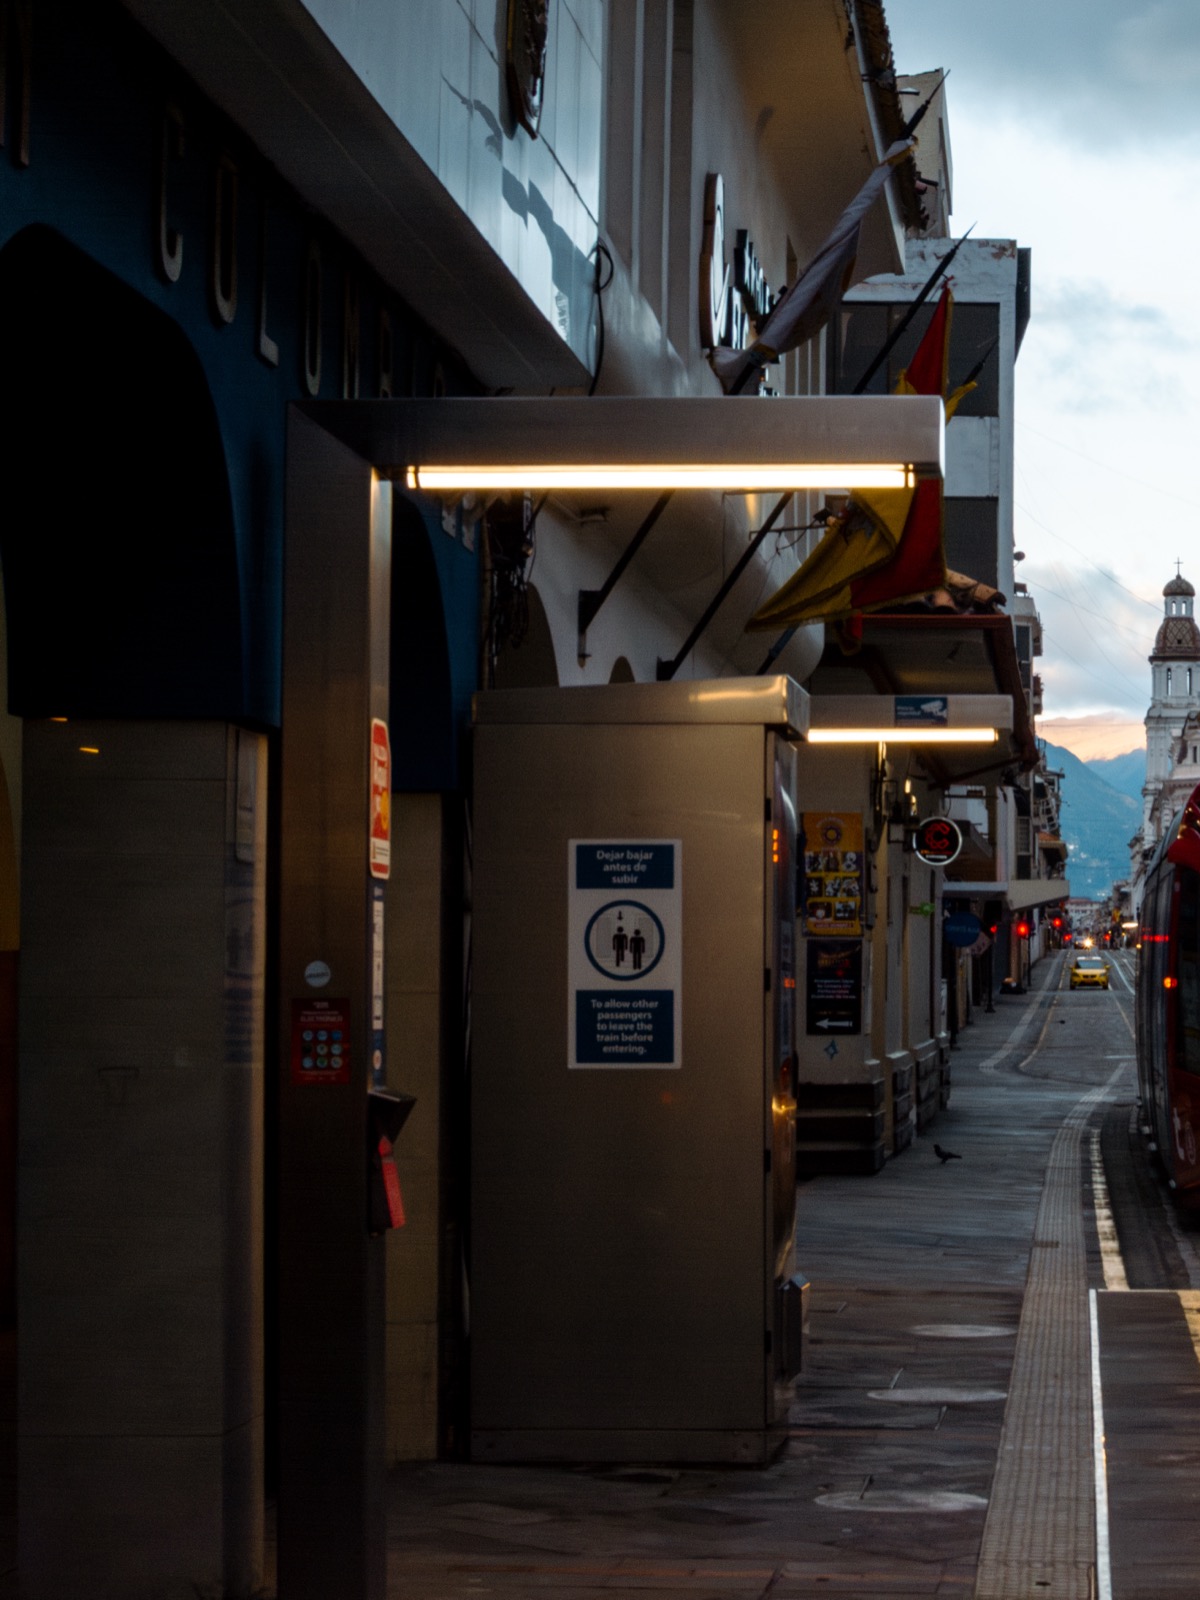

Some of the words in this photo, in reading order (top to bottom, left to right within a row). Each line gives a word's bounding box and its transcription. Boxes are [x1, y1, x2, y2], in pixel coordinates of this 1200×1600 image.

[596, 850, 625, 862] Dejar
[626, 849, 654, 863] bajar
[603, 862, 632, 873] antes
[633, 861, 647, 873] de
[611, 874, 639, 884] subir
[590, 999, 603, 1009] To
[604, 998, 631, 1008] allow
[632, 998, 659, 1008] other
[597, 1011, 653, 1022] passengers
[596, 1022, 607, 1031] to
[609, 1021, 635, 1031] leave
[636, 1021, 653, 1031] the
[596, 1033, 620, 1042] train
[621, 1032, 654, 1042] before
[602, 1043, 648, 1056] entering.
